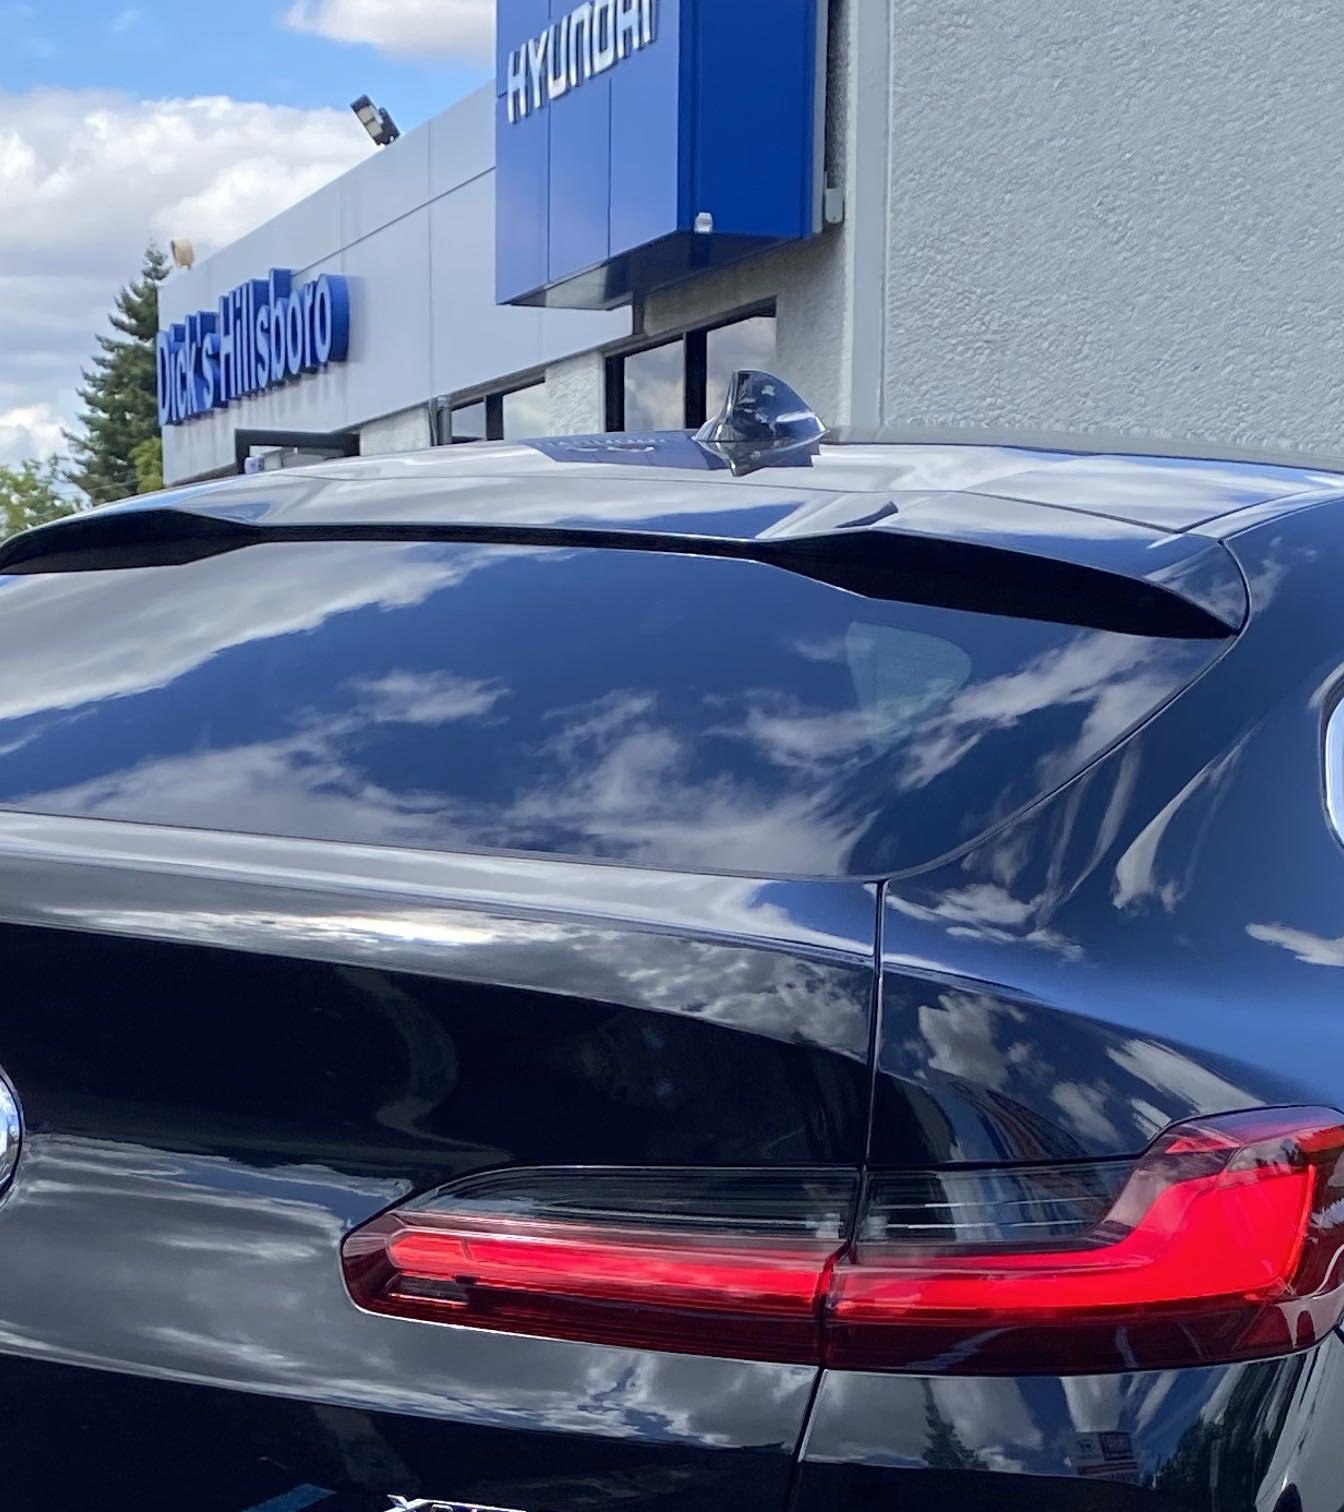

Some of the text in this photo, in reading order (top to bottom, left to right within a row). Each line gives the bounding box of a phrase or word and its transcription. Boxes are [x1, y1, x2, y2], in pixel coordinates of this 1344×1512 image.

[507, 0, 651, 124] HYUNDAI
[157, 270, 332, 426] Dick's Hillsboro
